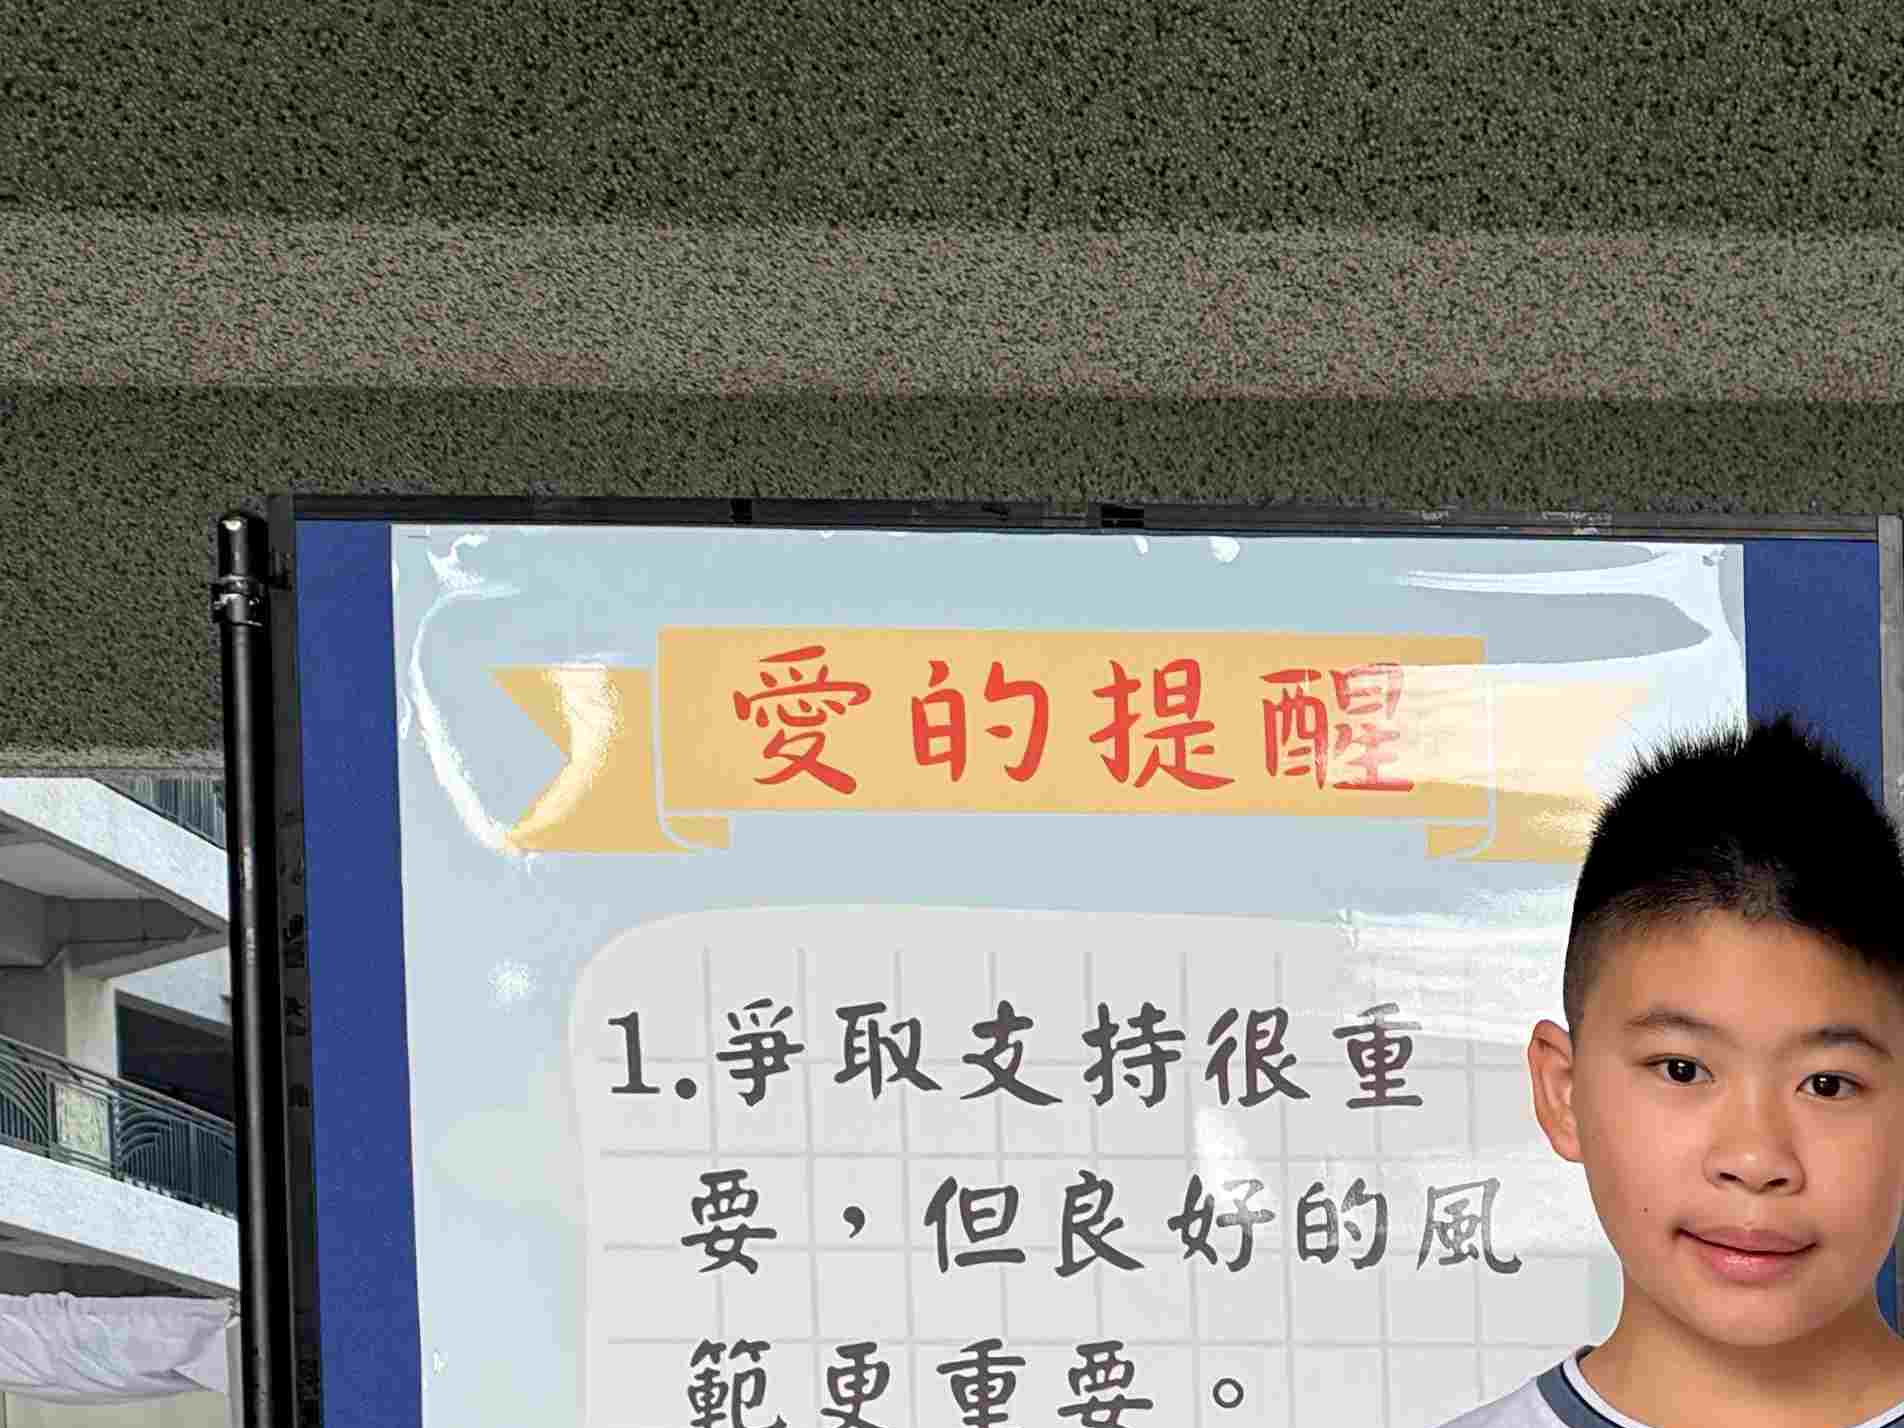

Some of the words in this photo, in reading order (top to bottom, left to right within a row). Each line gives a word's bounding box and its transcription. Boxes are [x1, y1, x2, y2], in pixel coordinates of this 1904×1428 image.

[733, 644, 1415, 794] 愛的提醒
[605, 996, 1426, 1113] 1.爭取支持很重
[679, 1167, 1524, 1279] 要，但良好的風
